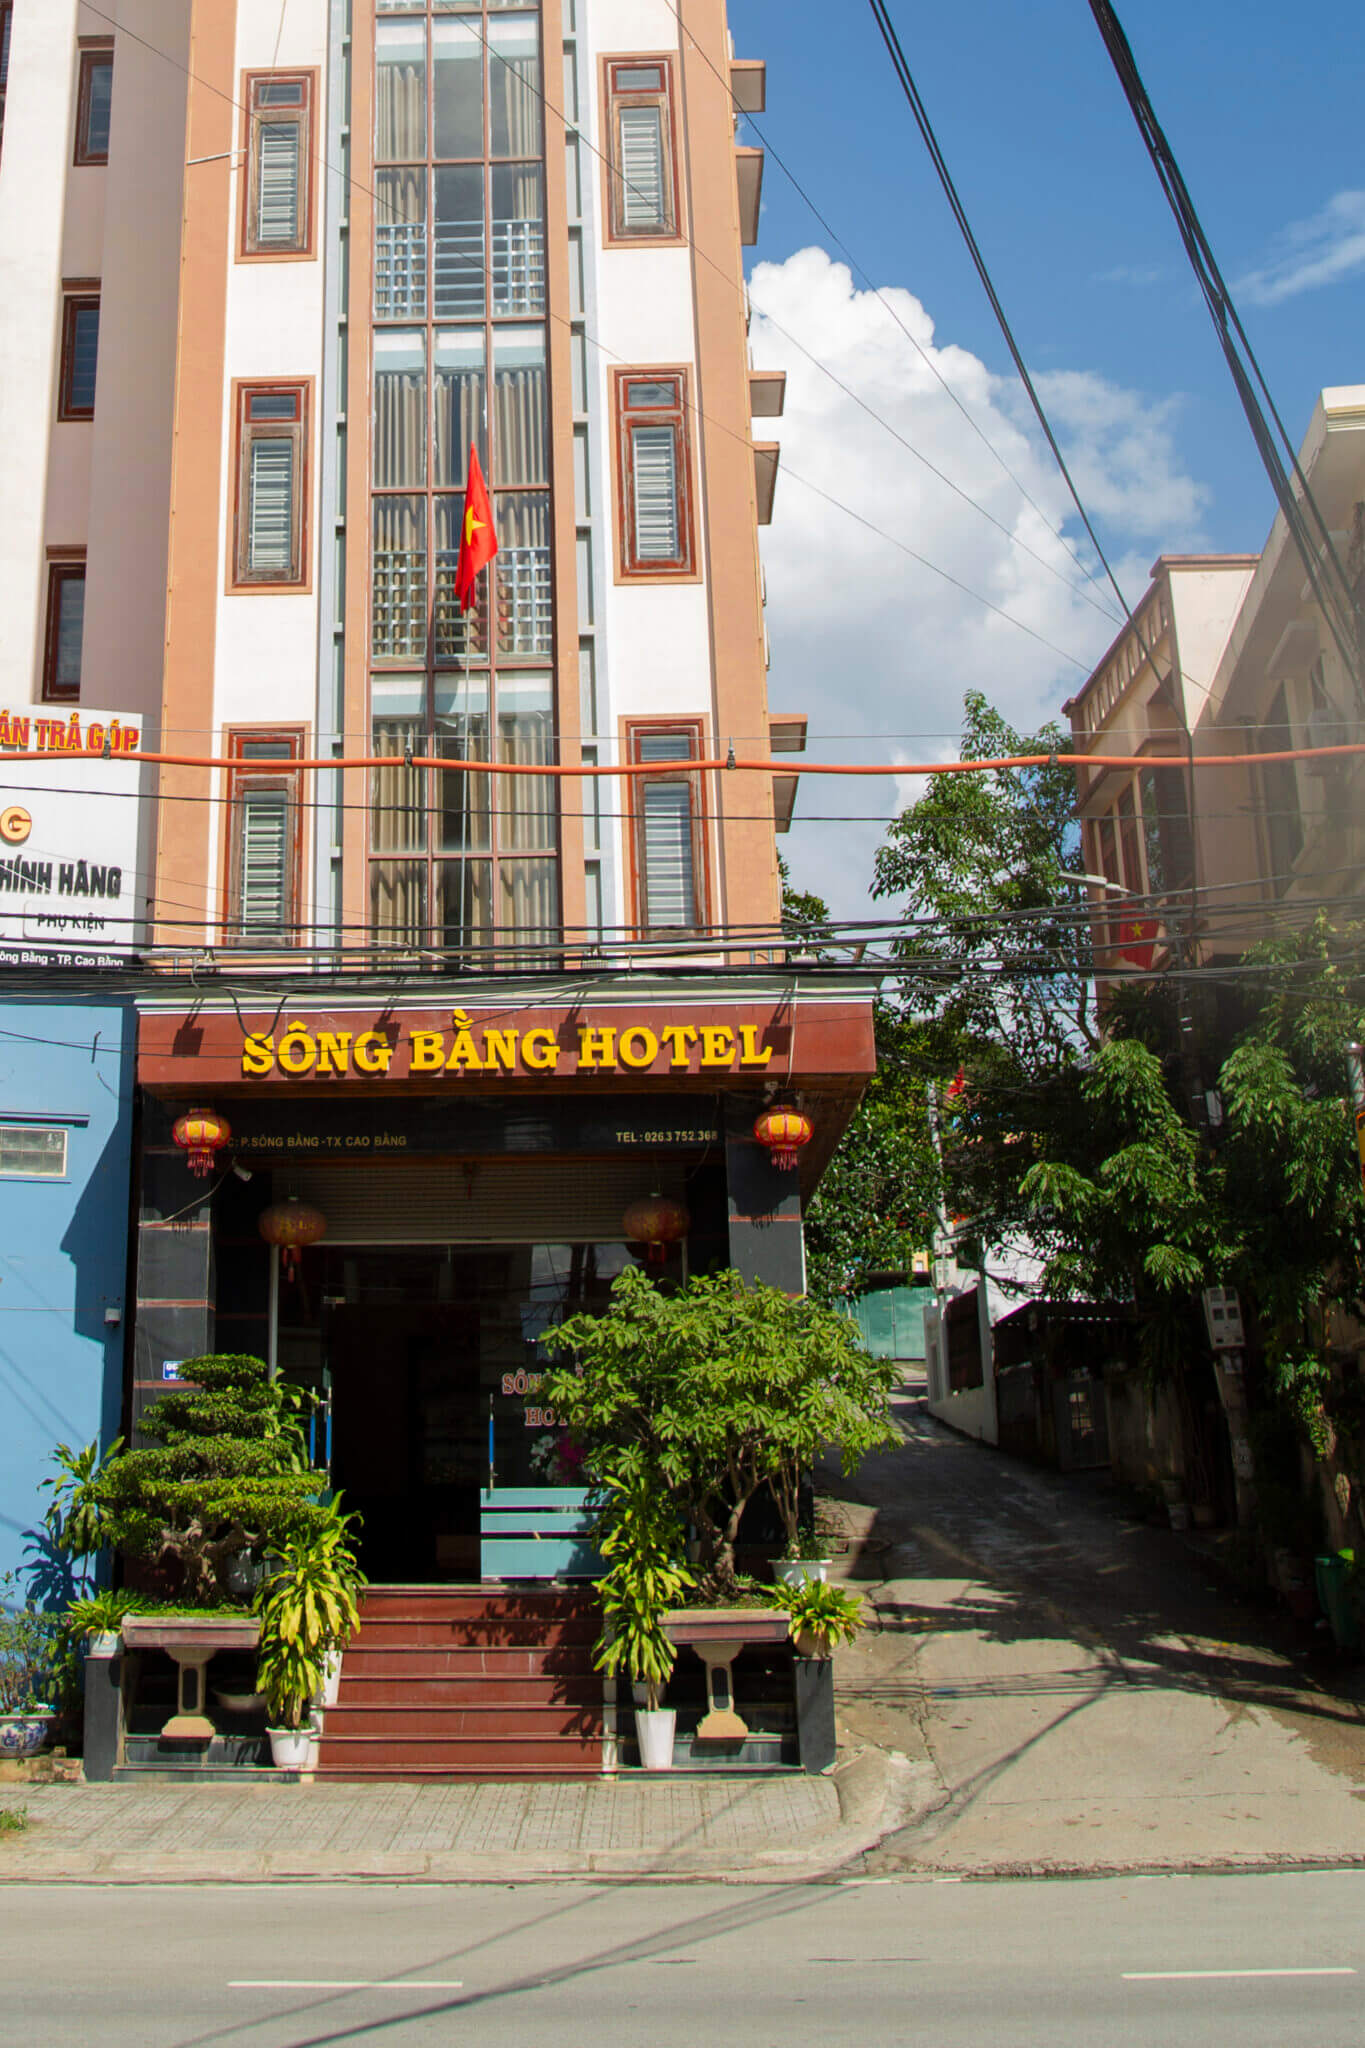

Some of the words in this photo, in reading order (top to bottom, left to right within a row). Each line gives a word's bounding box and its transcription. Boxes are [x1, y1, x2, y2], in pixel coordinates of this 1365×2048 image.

[35, 712, 83, 751] TRẢ
[87, 718, 140, 752] GÓP
[75, 955, 95, 966] Cao
[242, 1020, 394, 1074] SÔNG
[409, 1008, 561, 1071] BẰNG
[577, 1025, 773, 1068] HOTEL
[345, 1136, 371, 1148] CAO
